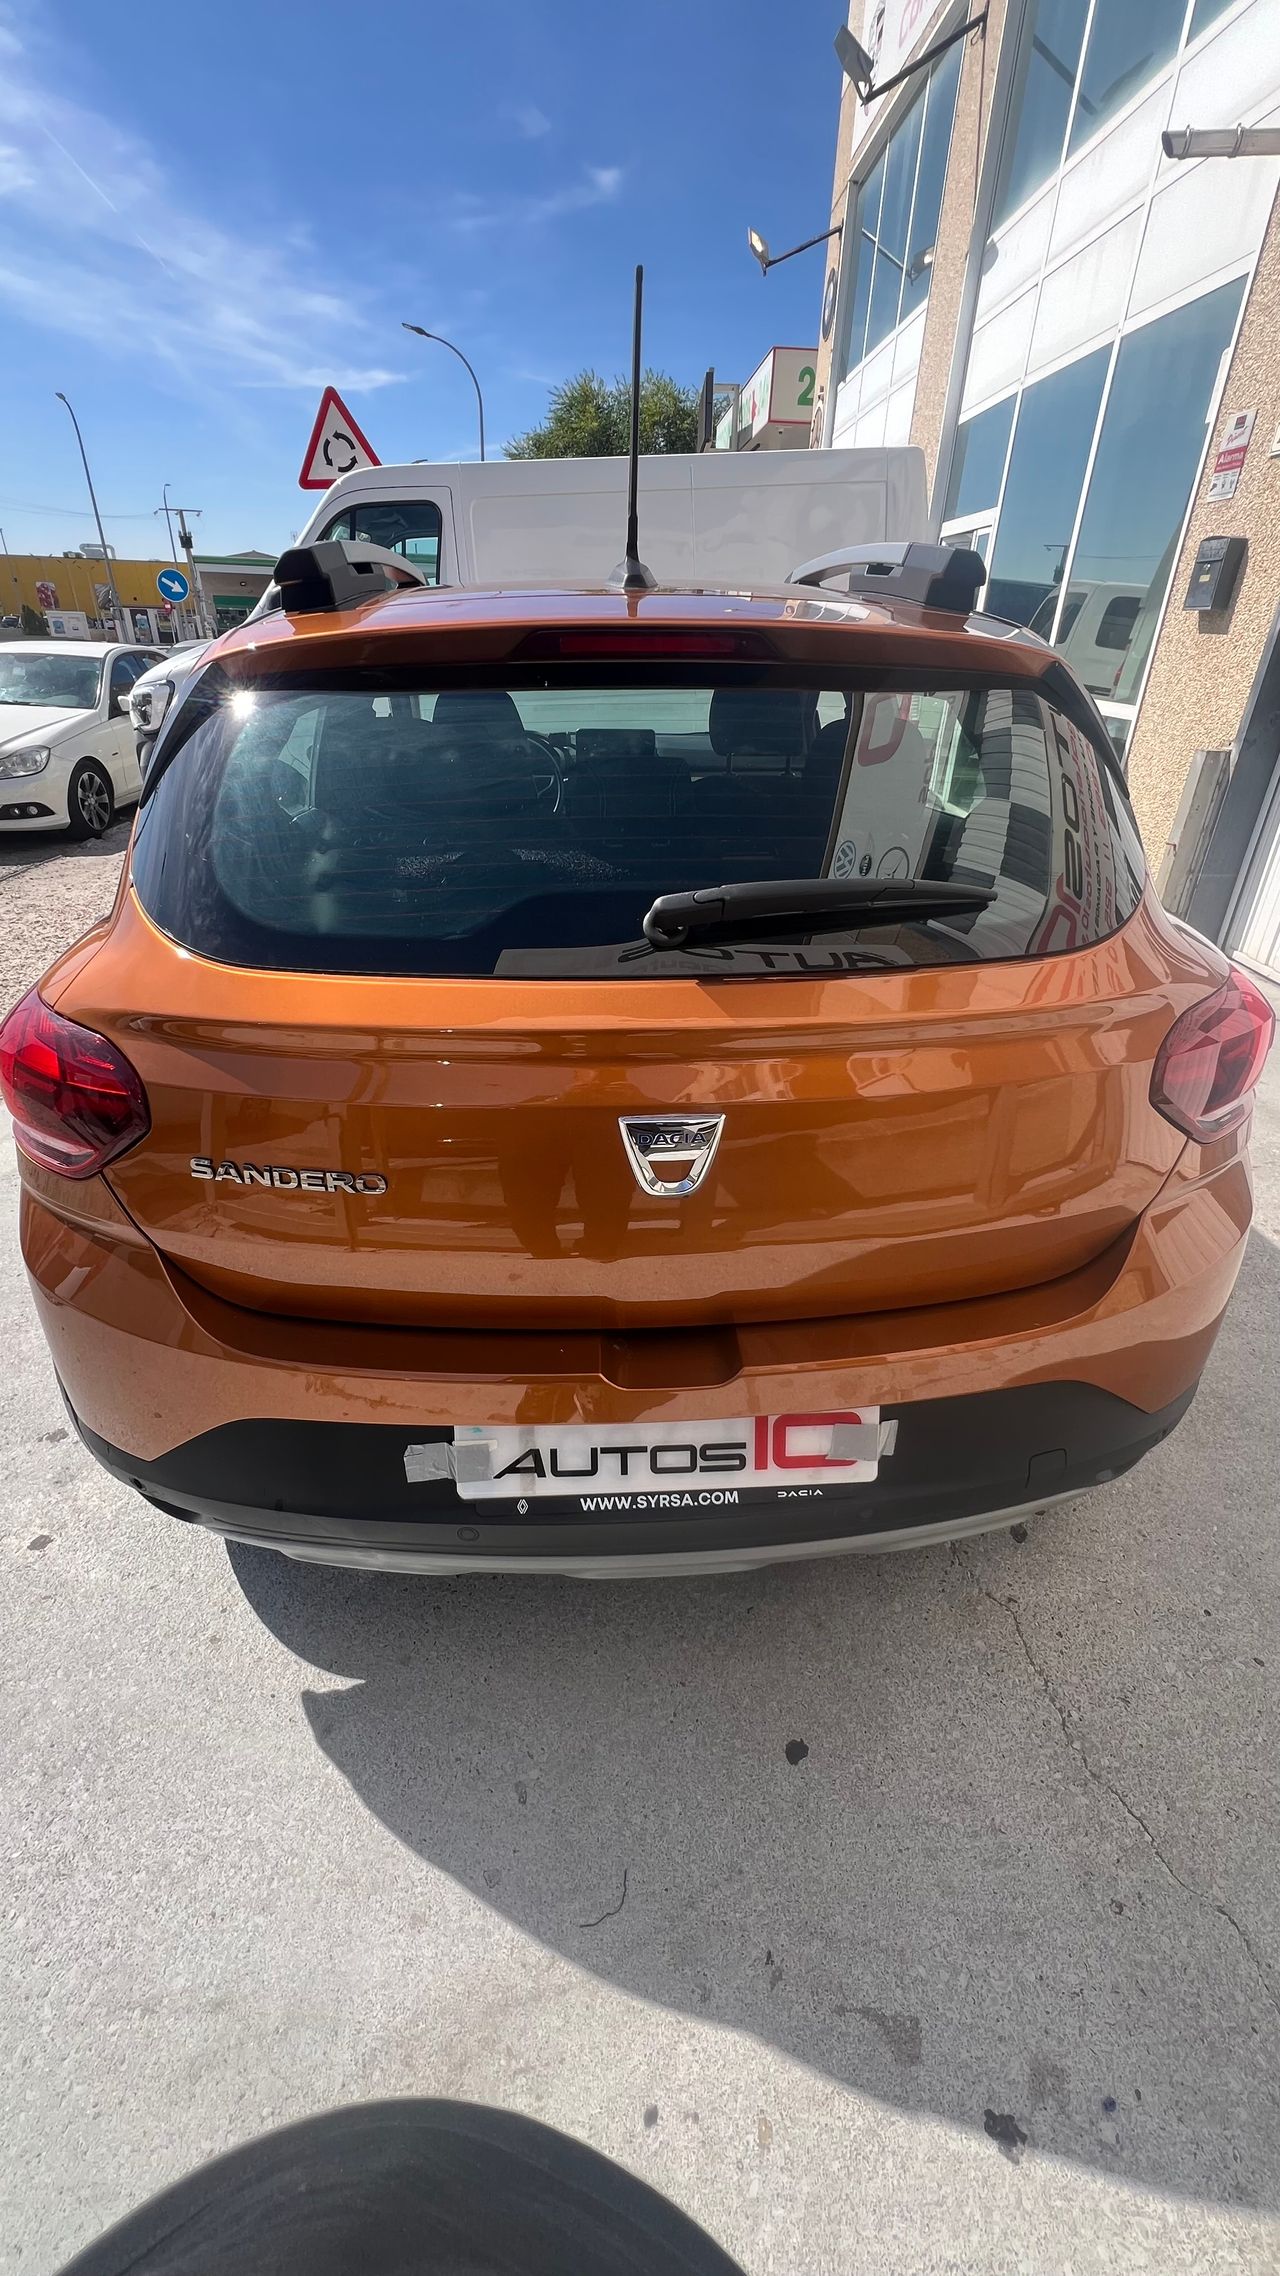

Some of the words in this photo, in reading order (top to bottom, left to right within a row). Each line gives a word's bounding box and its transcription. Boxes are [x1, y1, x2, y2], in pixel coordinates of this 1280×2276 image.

[638, 1131, 707, 1146] DACIA
[189, 1156, 389, 1196] SANDERO
[579, 1490, 740, 1513] WWW.SYRSA.COM
[777, 1488, 824, 1498] DACIA
